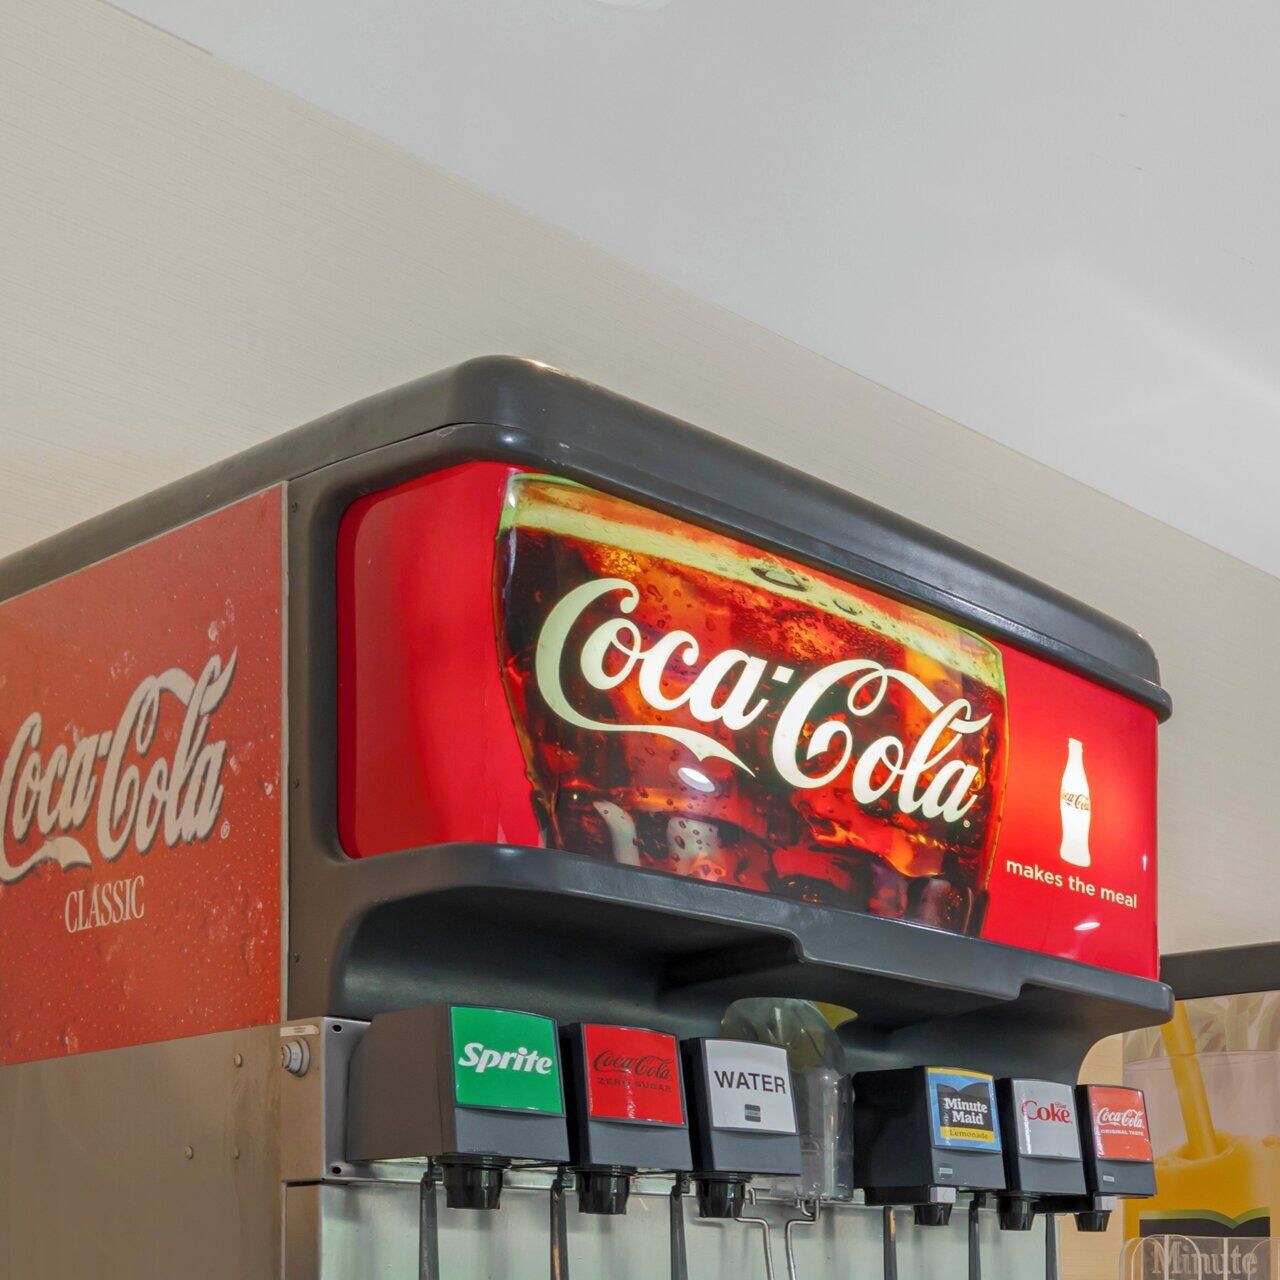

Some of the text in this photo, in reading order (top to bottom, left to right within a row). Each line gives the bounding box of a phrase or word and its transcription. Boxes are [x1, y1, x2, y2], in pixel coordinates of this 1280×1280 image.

[1006, 859, 1138, 910] makes the meal
[65, 875, 145, 934] CLASSIC
[458, 1042, 553, 1075] Sprite
[597, 1076, 631, 1088] ZERO
[714, 1070, 787, 1095] WATER
[944, 1097, 989, 1115] Minute
[952, 1110, 985, 1126] Maid
[1021, 1100, 1071, 1123] Coke
[949, 1128, 990, 1141] Lemonade
[1152, 1240, 1258, 1275] Minute
